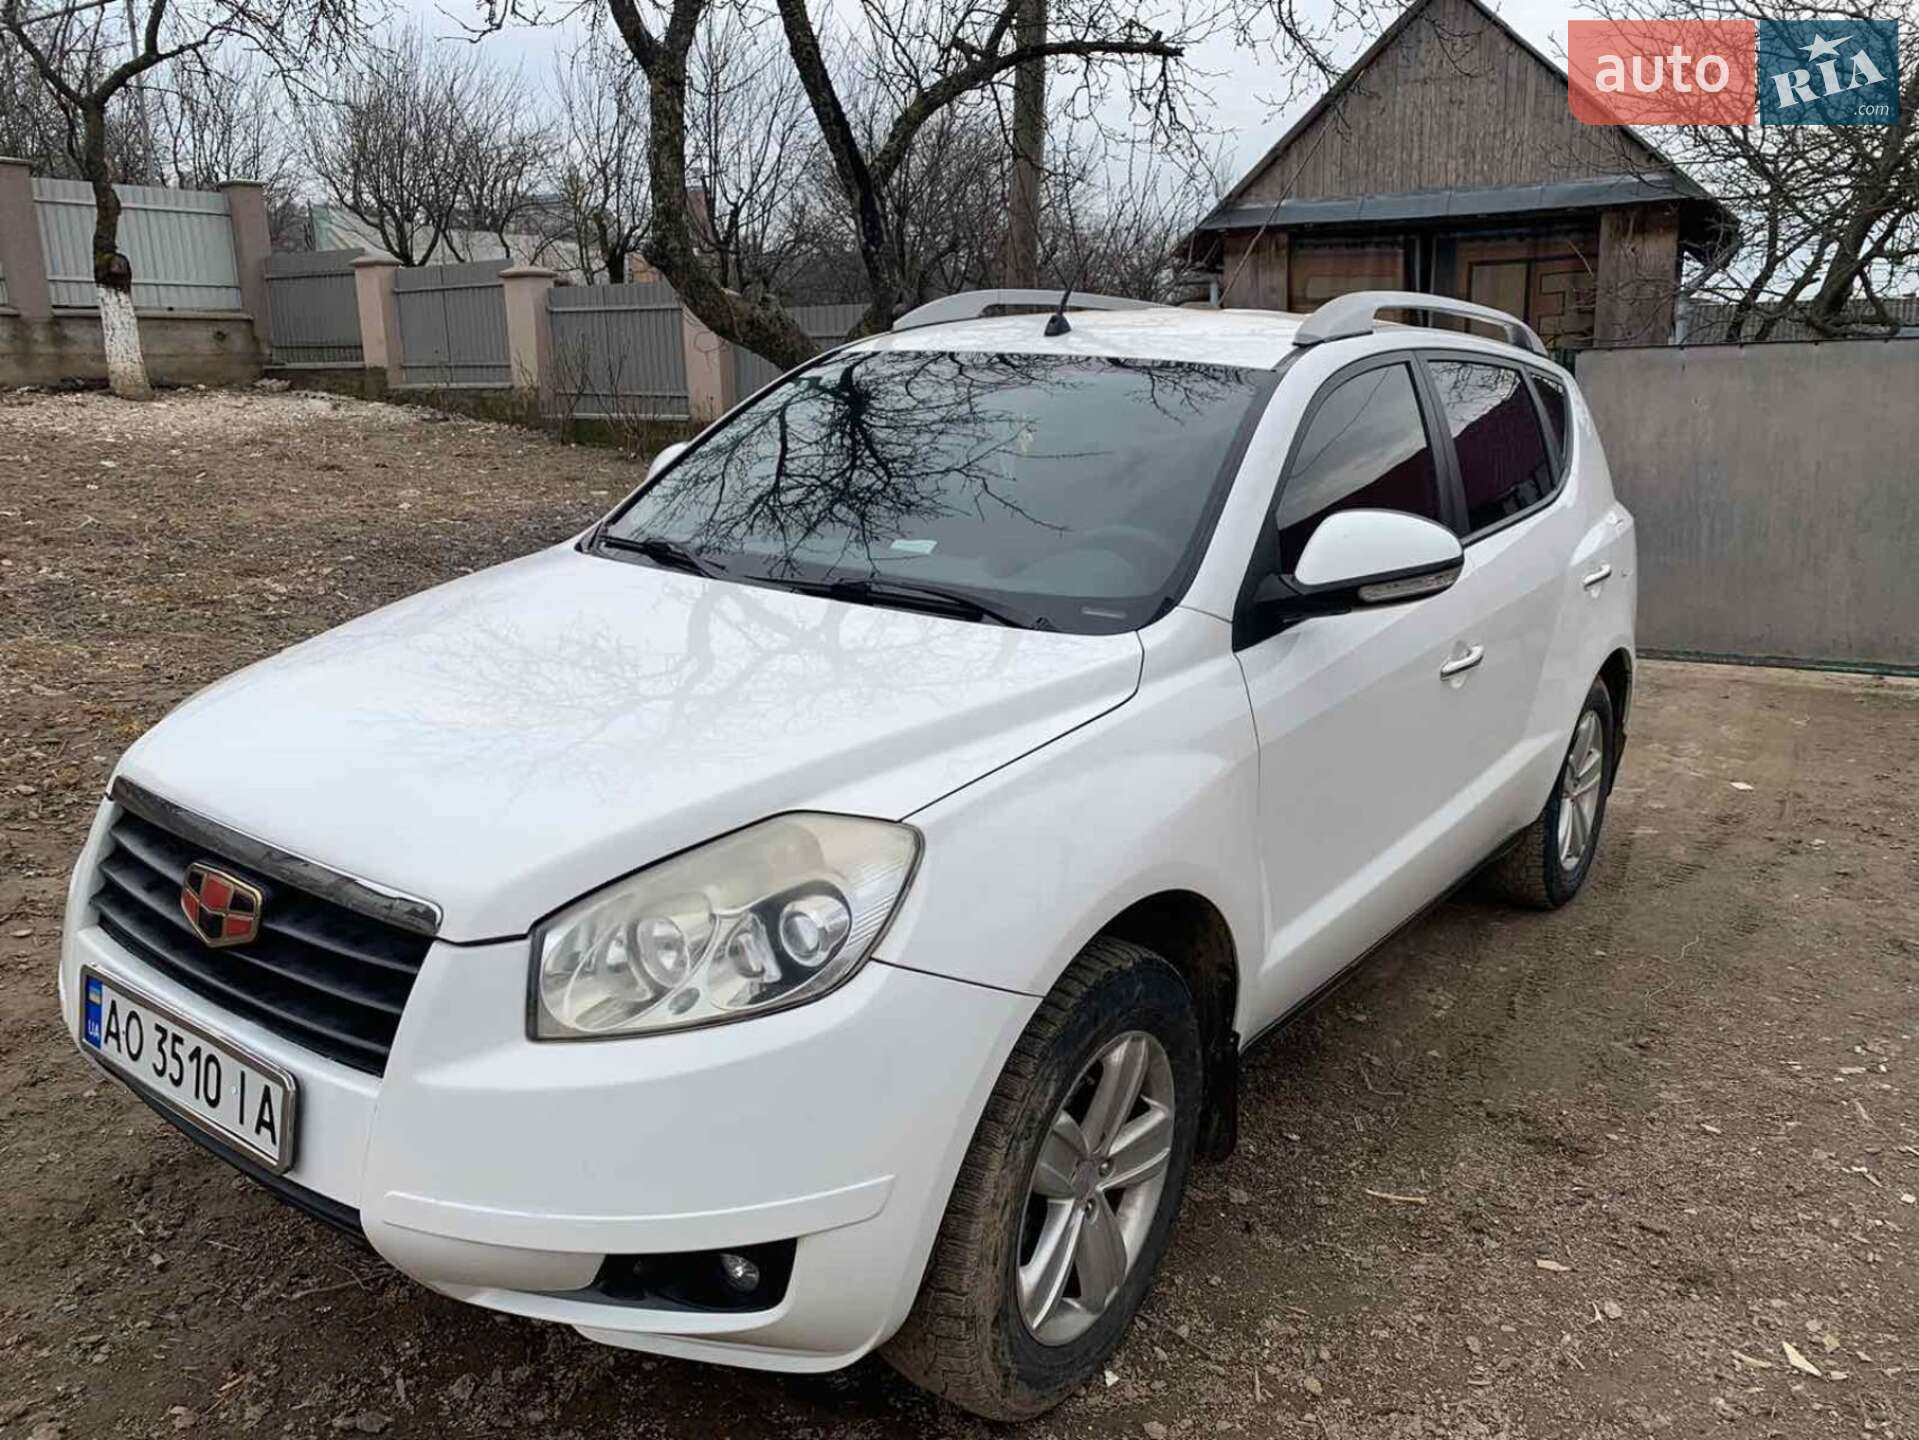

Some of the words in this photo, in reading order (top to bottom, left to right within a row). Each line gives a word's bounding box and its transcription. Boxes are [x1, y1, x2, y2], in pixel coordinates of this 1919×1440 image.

[87, 1019, 100, 1037] UA
[104, 1000, 144, 1061] AO
[152, 1023, 222, 1109] 3510
[238, 1070, 277, 1146] IA
